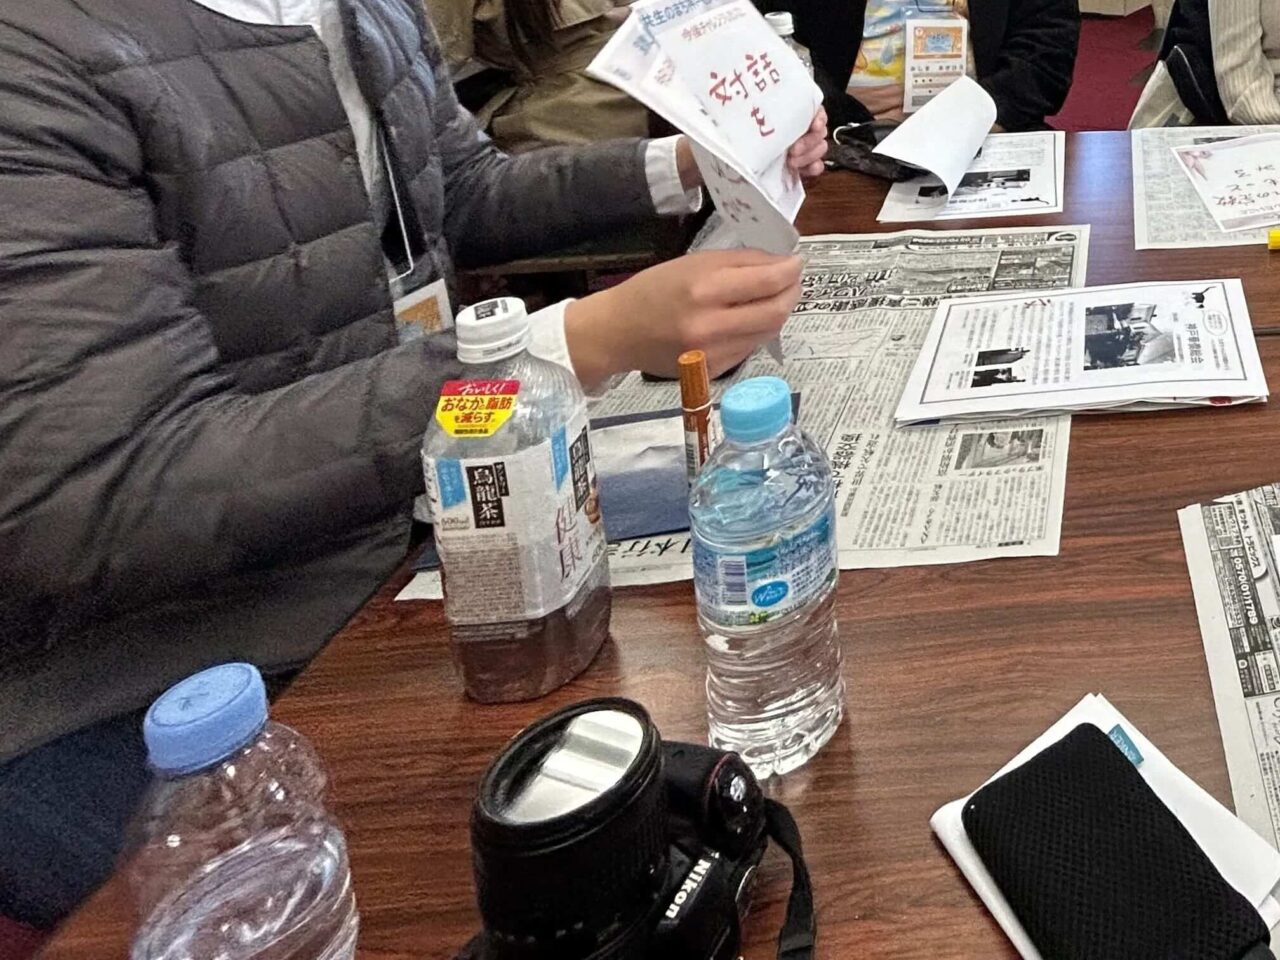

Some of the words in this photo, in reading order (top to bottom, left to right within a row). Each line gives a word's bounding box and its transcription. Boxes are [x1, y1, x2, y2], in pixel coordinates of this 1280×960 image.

[709, 52, 781, 106] 対話
[750, 105, 776, 137] を
[473, 467, 499, 520] 烏龍茶
[1232, 556, 1258, 625] 0570(01)1789
[665, 859, 712, 919] Nikon
